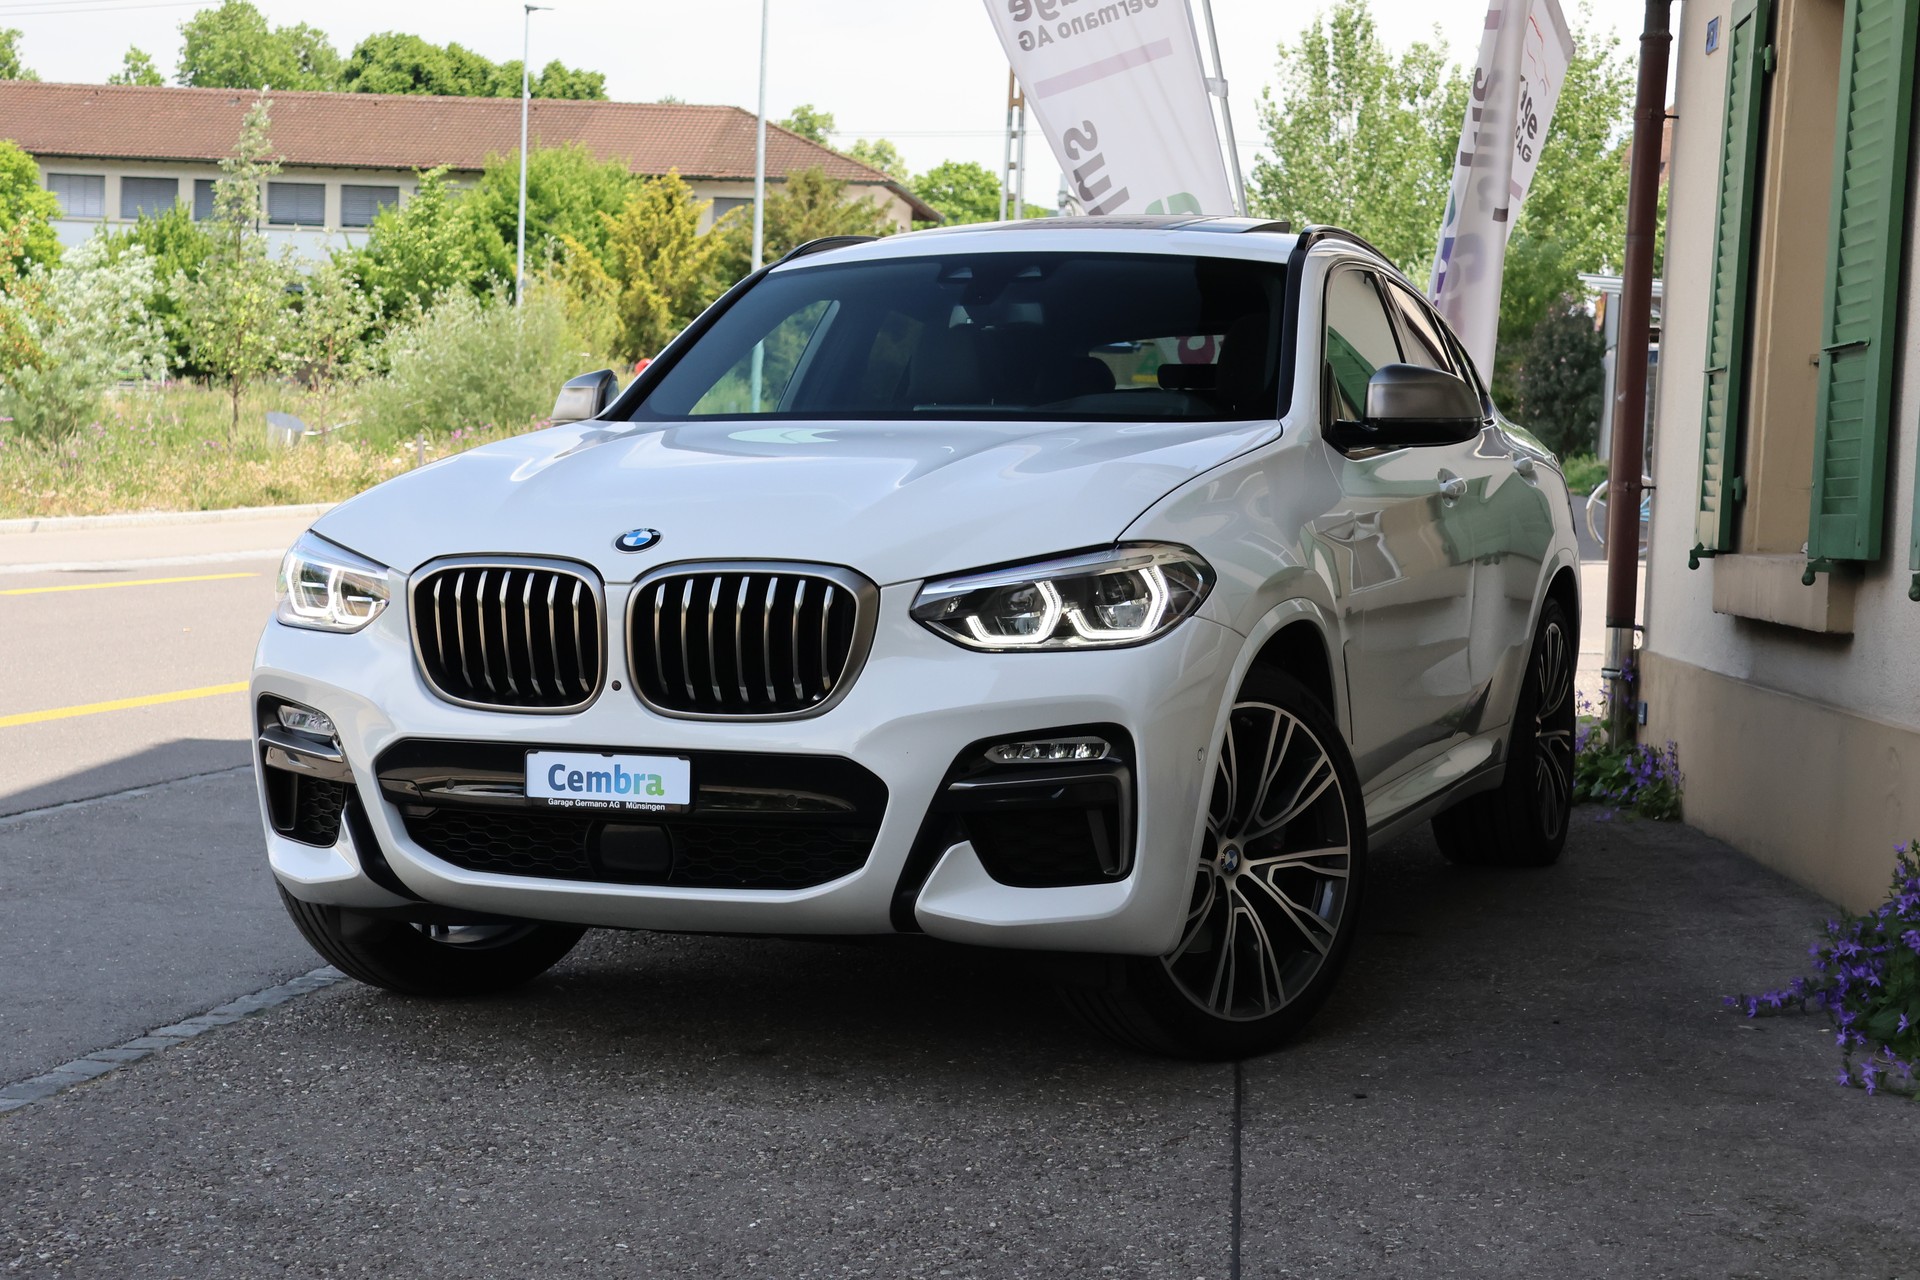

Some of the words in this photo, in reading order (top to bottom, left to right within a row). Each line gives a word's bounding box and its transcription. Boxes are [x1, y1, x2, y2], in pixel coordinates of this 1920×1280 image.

[548, 763, 665, 796] Cembra
[548, 798, 574, 807] Garage
[575, 799, 608, 808] Germano
[609, 801, 620, 809] AG
[625, 801, 666, 811] Münsingen
